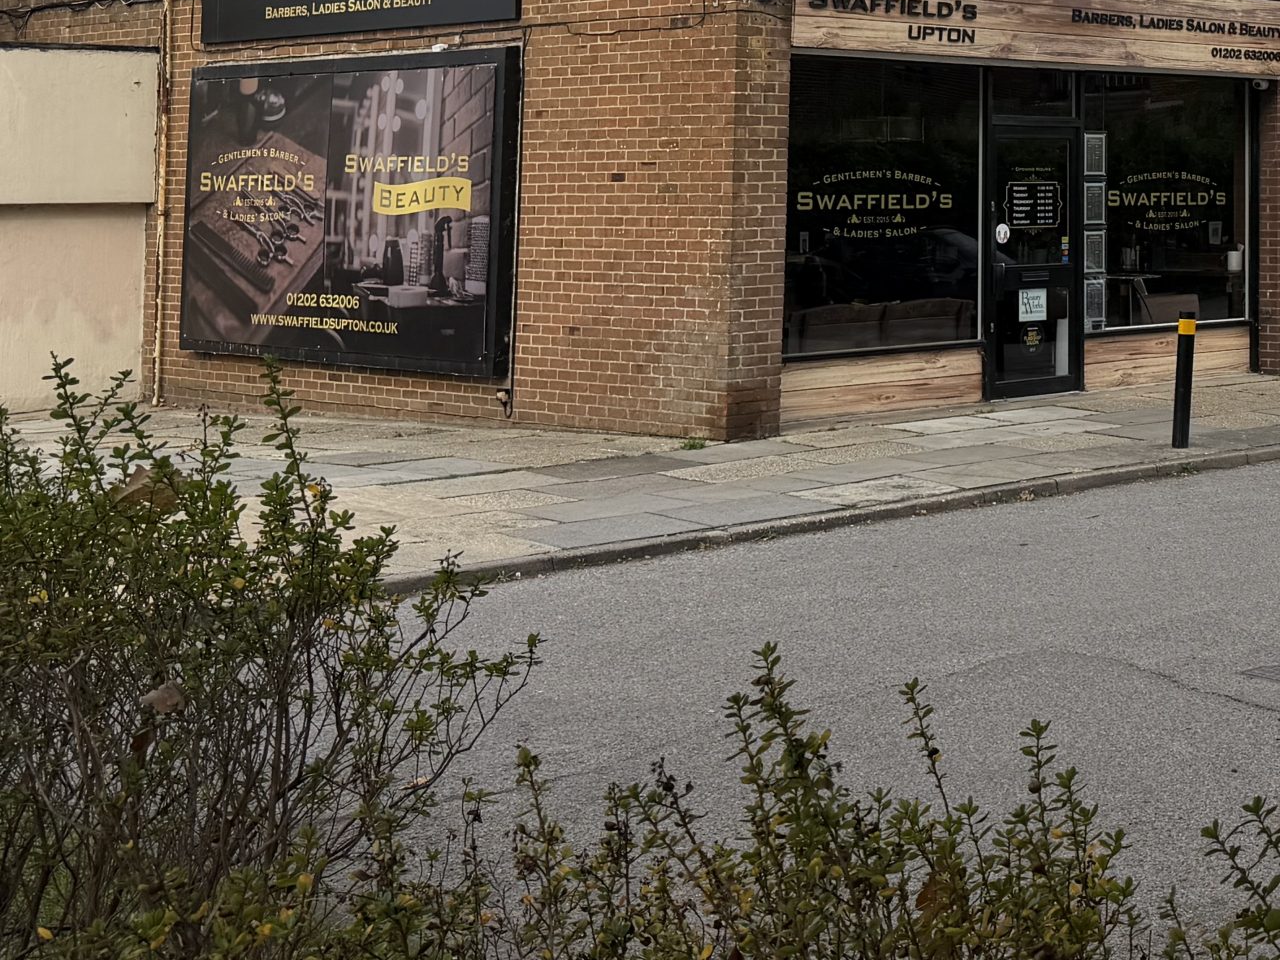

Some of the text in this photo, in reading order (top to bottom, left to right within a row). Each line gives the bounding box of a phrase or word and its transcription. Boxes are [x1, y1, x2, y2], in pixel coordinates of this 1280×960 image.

[265, 5, 310, 20] BARBERS,
[312, 1, 346, 16] LADIES
[1071, 8, 1136, 30] BARBERS,
[1139, 14, 1184, 31] LADIES
[1185, 17, 1226, 35] SALON
[1227, 22, 1238, 36] &
[907, 24, 976, 44] UPTON
[1211, 47, 1242, 60] 01202
[218, 147, 299, 164] GENTLEMEN'S BARBER
[344, 152, 469, 173] SWAFFIELD'S
[199, 171, 314, 192] SWAFFIELD'S
[823, 169, 932, 185] GENTLEMEN'S BARBER
[1126, 171, 1210, 184] GENTLEMEN'S BARBER
[379, 185, 464, 208] BEAUTY
[796, 191, 953, 211] SWAFFIELD'S
[1107, 190, 1226, 207] SWAFFIELD'S
[833, 227, 841, 236] &
[885, 226, 917, 238] SALON
[1174, 220, 1200, 230] SALON
[286, 292, 360, 309] 01202 632006
[250, 313, 398, 335] WWW.SWAFFIELDSUPTON.CO.UK
